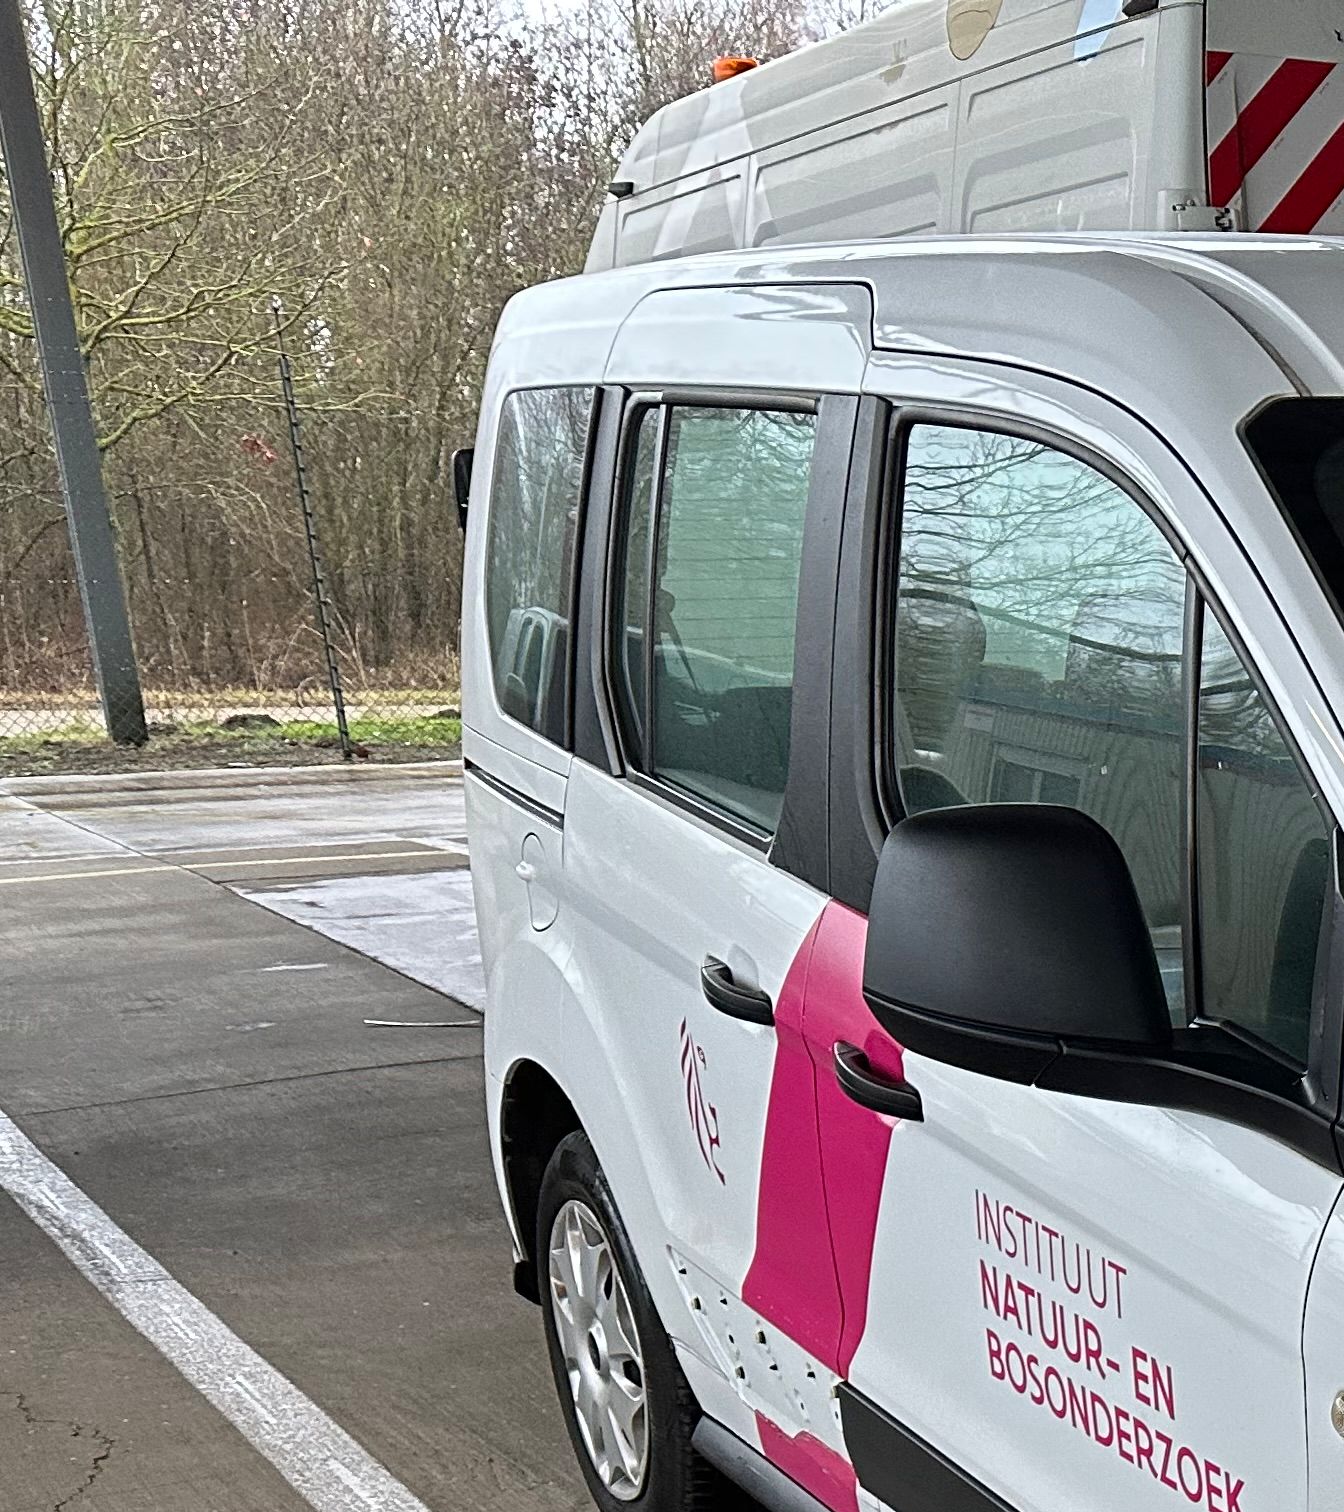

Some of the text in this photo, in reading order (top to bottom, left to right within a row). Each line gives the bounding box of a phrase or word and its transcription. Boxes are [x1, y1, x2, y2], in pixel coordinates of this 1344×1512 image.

[975, 1189, 1127, 1319] INSTITUUT
[980, 1259, 1175, 1420] NATUUR- EN
